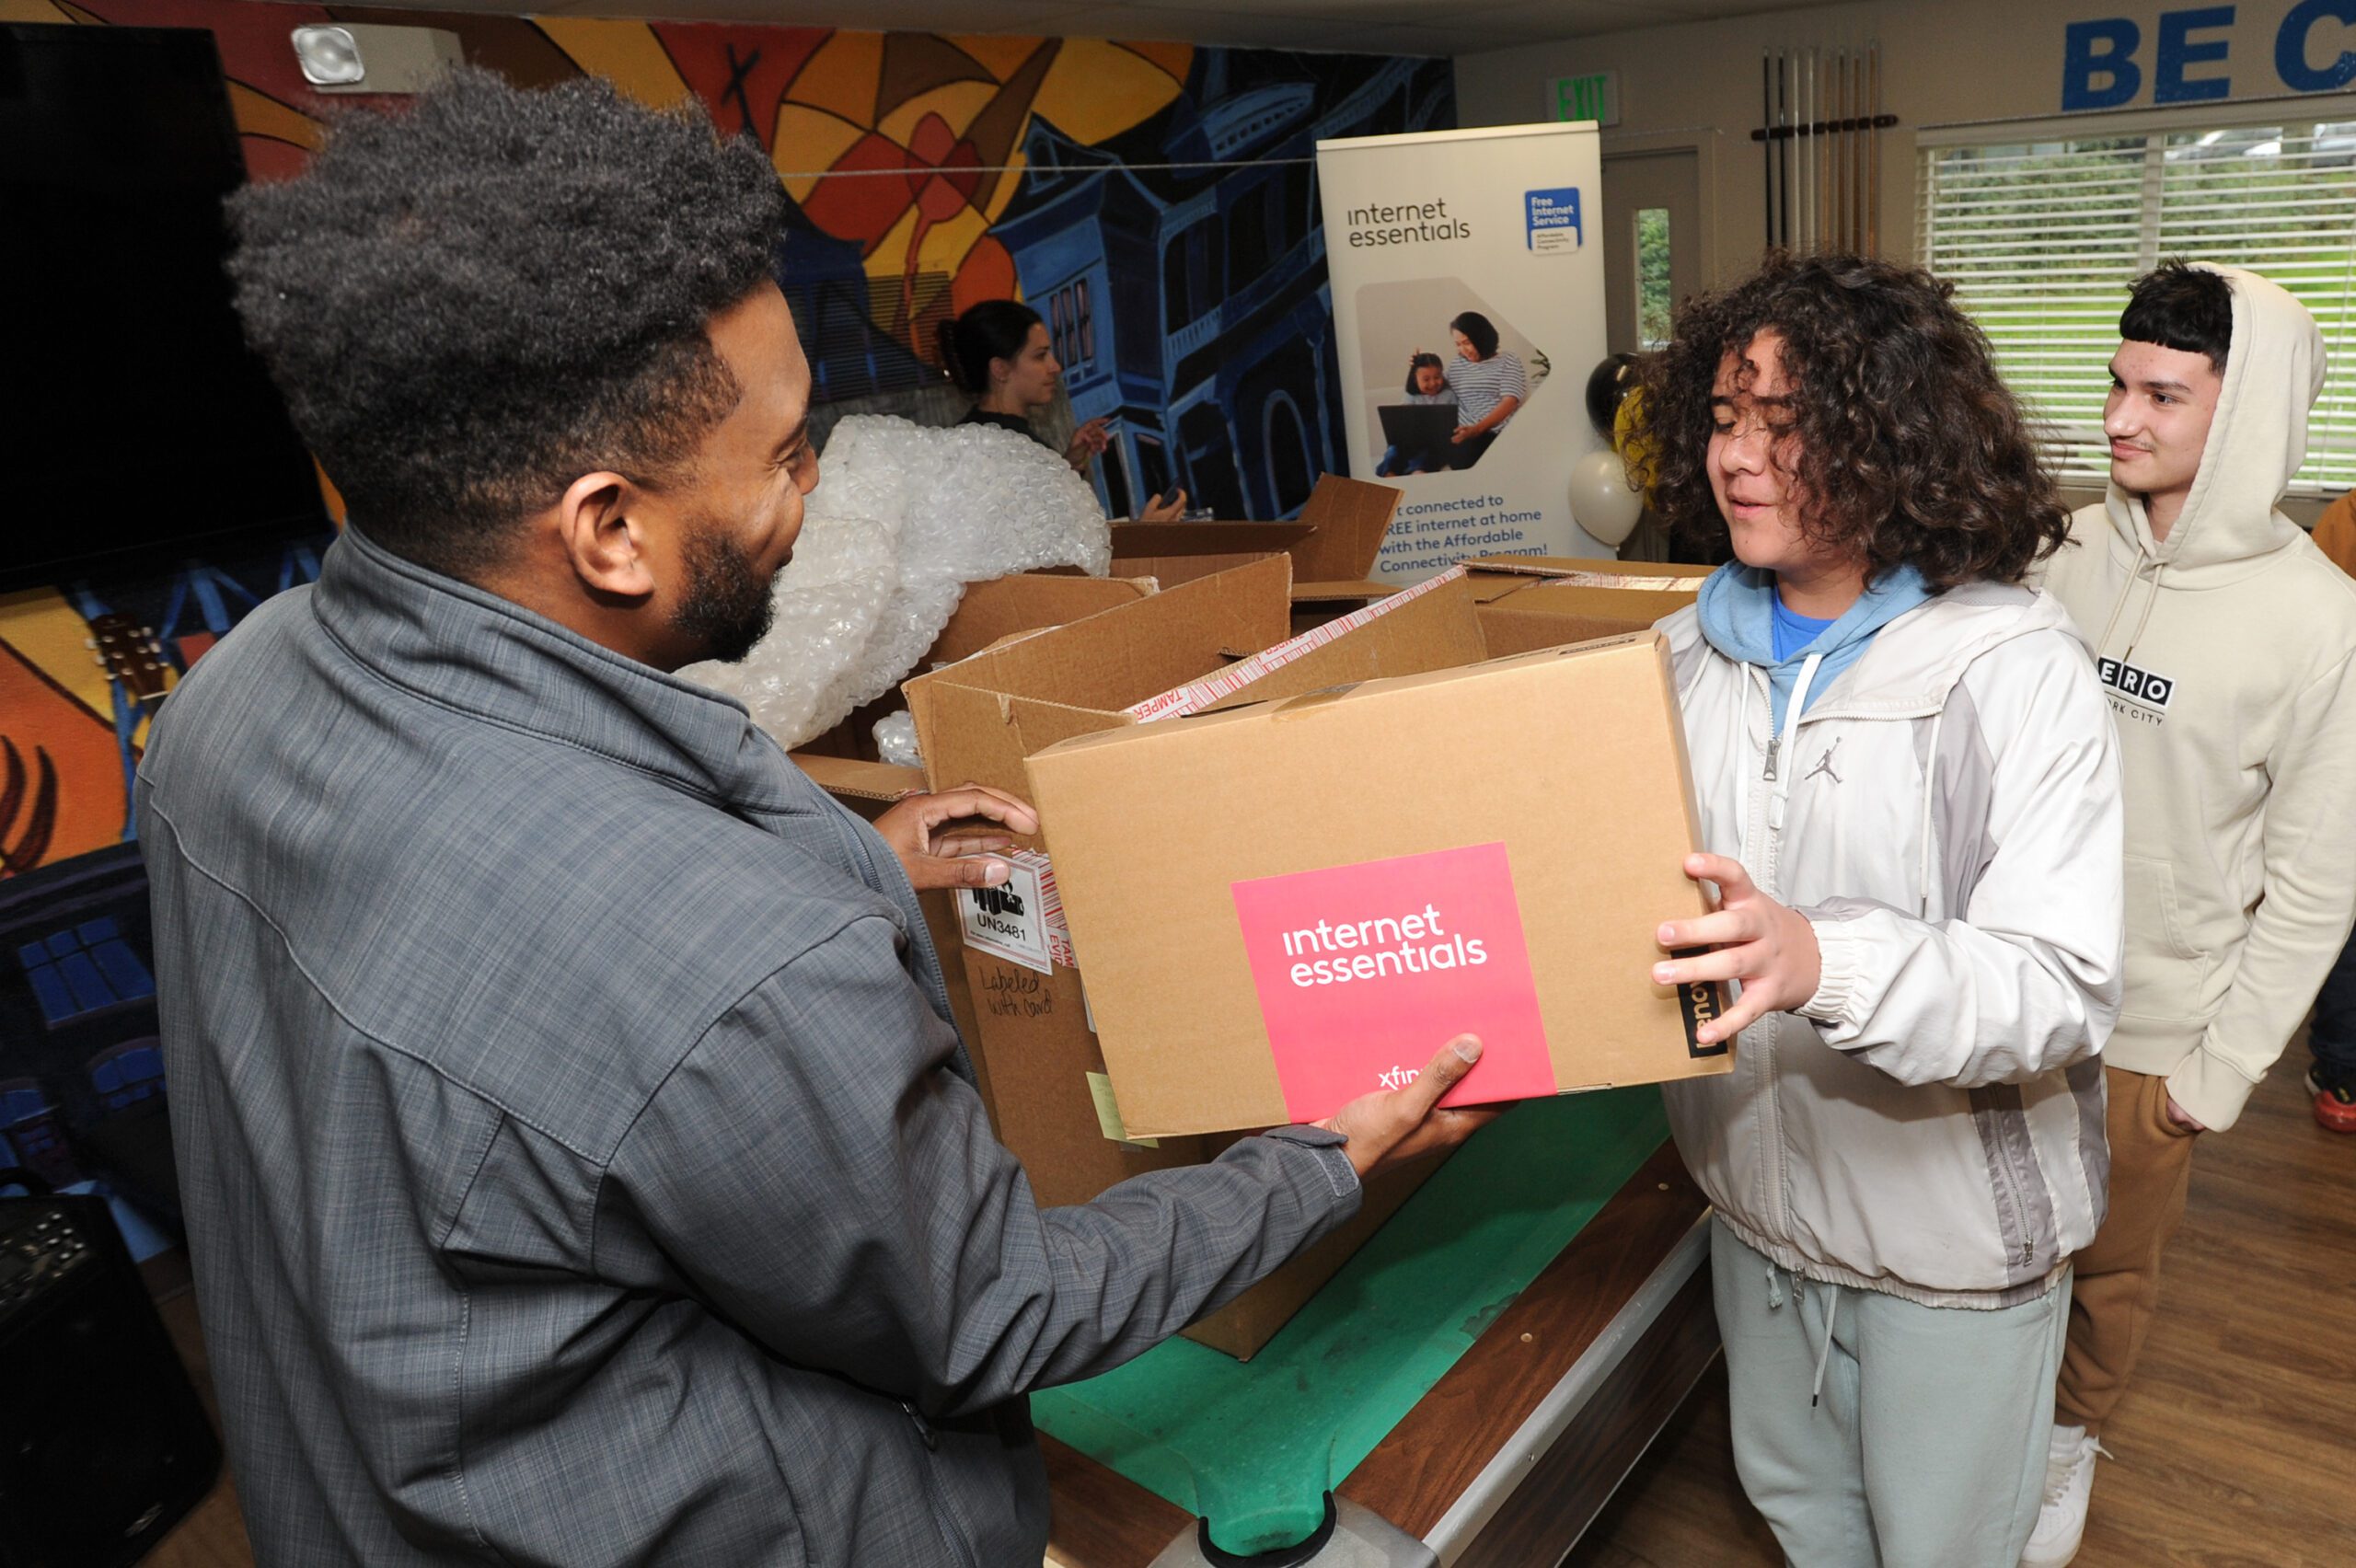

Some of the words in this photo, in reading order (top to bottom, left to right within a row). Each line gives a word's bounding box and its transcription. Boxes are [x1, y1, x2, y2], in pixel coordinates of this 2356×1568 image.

[2062, 6, 2236, 111] BE
[1558, 76, 1607, 121] EXIT
[1347, 198, 1447, 225] internet
[1531, 197, 1553, 207] Free
[1531, 204, 1575, 216] Internet
[1349, 219, 1471, 248] essentials
[1532, 216, 1570, 226] Service
[1406, 495, 1485, 515] connected
[1489, 495, 1504, 506] to
[1386, 521, 1413, 536] REE
[1415, 513, 1477, 533] internet
[1480, 514, 1496, 527] at
[1499, 509, 1542, 525] home
[1380, 539, 1413, 555] with
[1415, 537, 1441, 552] the
[1443, 528, 1524, 549] Affordable
[1380, 552, 1474, 573] Connectivit
[2101, 662, 2166, 700] ERO
[1133, 689, 1184, 721] TAMPER
[2131, 709, 2163, 726] CITY
[976, 913, 1026, 941] UN3481
[1283, 904, 1445, 956] internet
[1290, 934, 1488, 987] essentials
[977, 966, 1039, 994] Labeled
[1378, 1066, 1423, 1090] xfin
